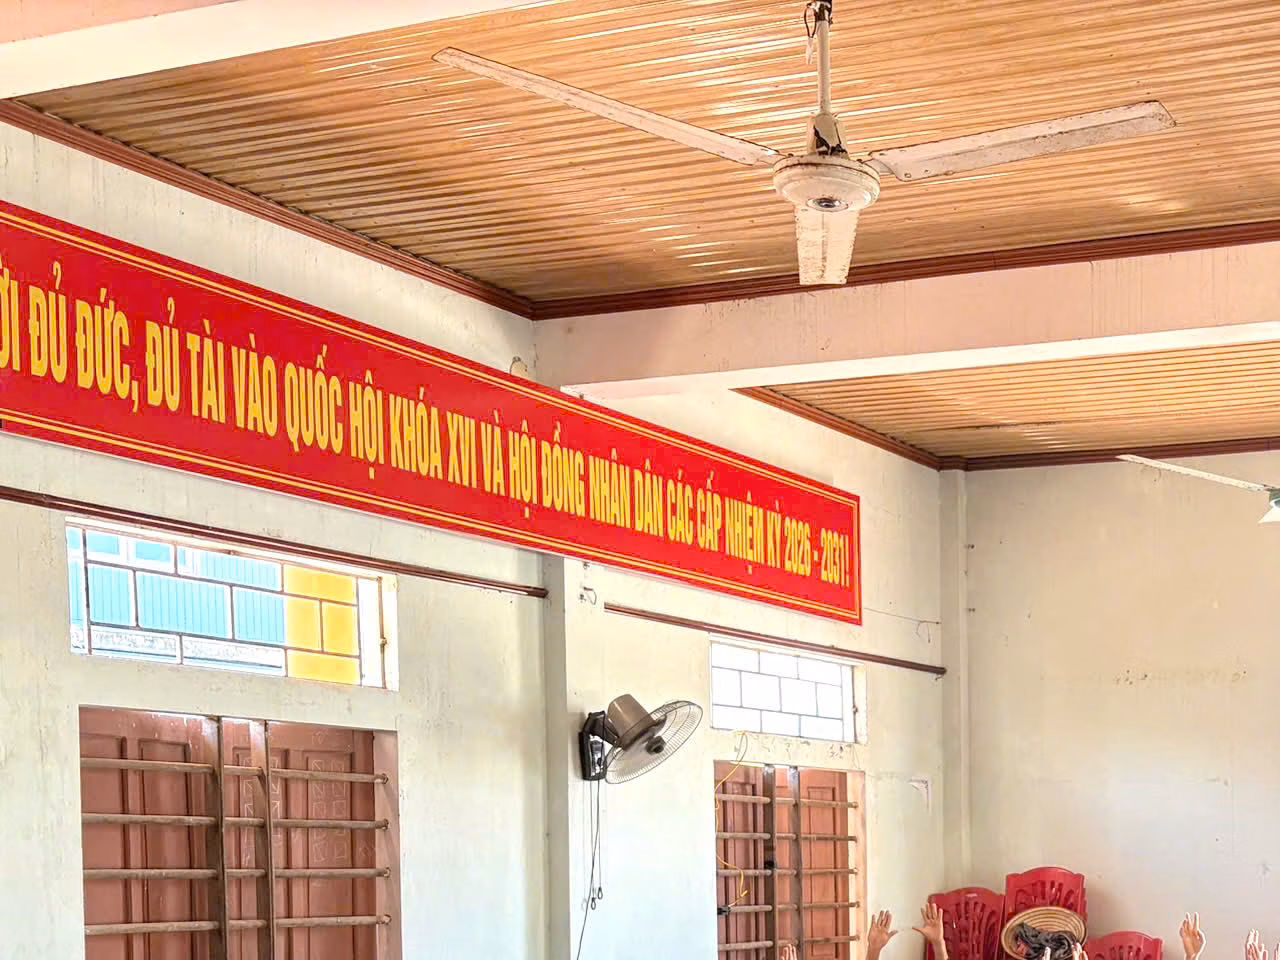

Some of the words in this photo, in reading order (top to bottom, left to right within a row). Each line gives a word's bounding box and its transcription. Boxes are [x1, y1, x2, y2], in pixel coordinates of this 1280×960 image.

[29, 261, 67, 383] ĐỦ
[75, 287, 139, 413] ĐỨC,
[145, 297, 180, 412] ĐỦ
[186, 319, 226, 424] TÀI
[231, 333, 277, 437] VÀO
[284, 344, 343, 453] QUỐC
[348, 370, 384, 479] HỘI
[389, 387, 443, 480] KHÓA
[446, 410, 477, 489] XVI
[480, 409, 505, 496] VÀ
[508, 419, 537, 519] HỘI
[540, 422, 585, 517] ĐỒNG
[588, 447, 631, 529] NHÂN
[633, 459, 664, 537] DÂN
[666, 466, 694, 545] CÁC
[696, 470, 722, 552] CẤP
[724, 490, 765, 575] NHIỆM
[784, 515, 812, 577] 2026
